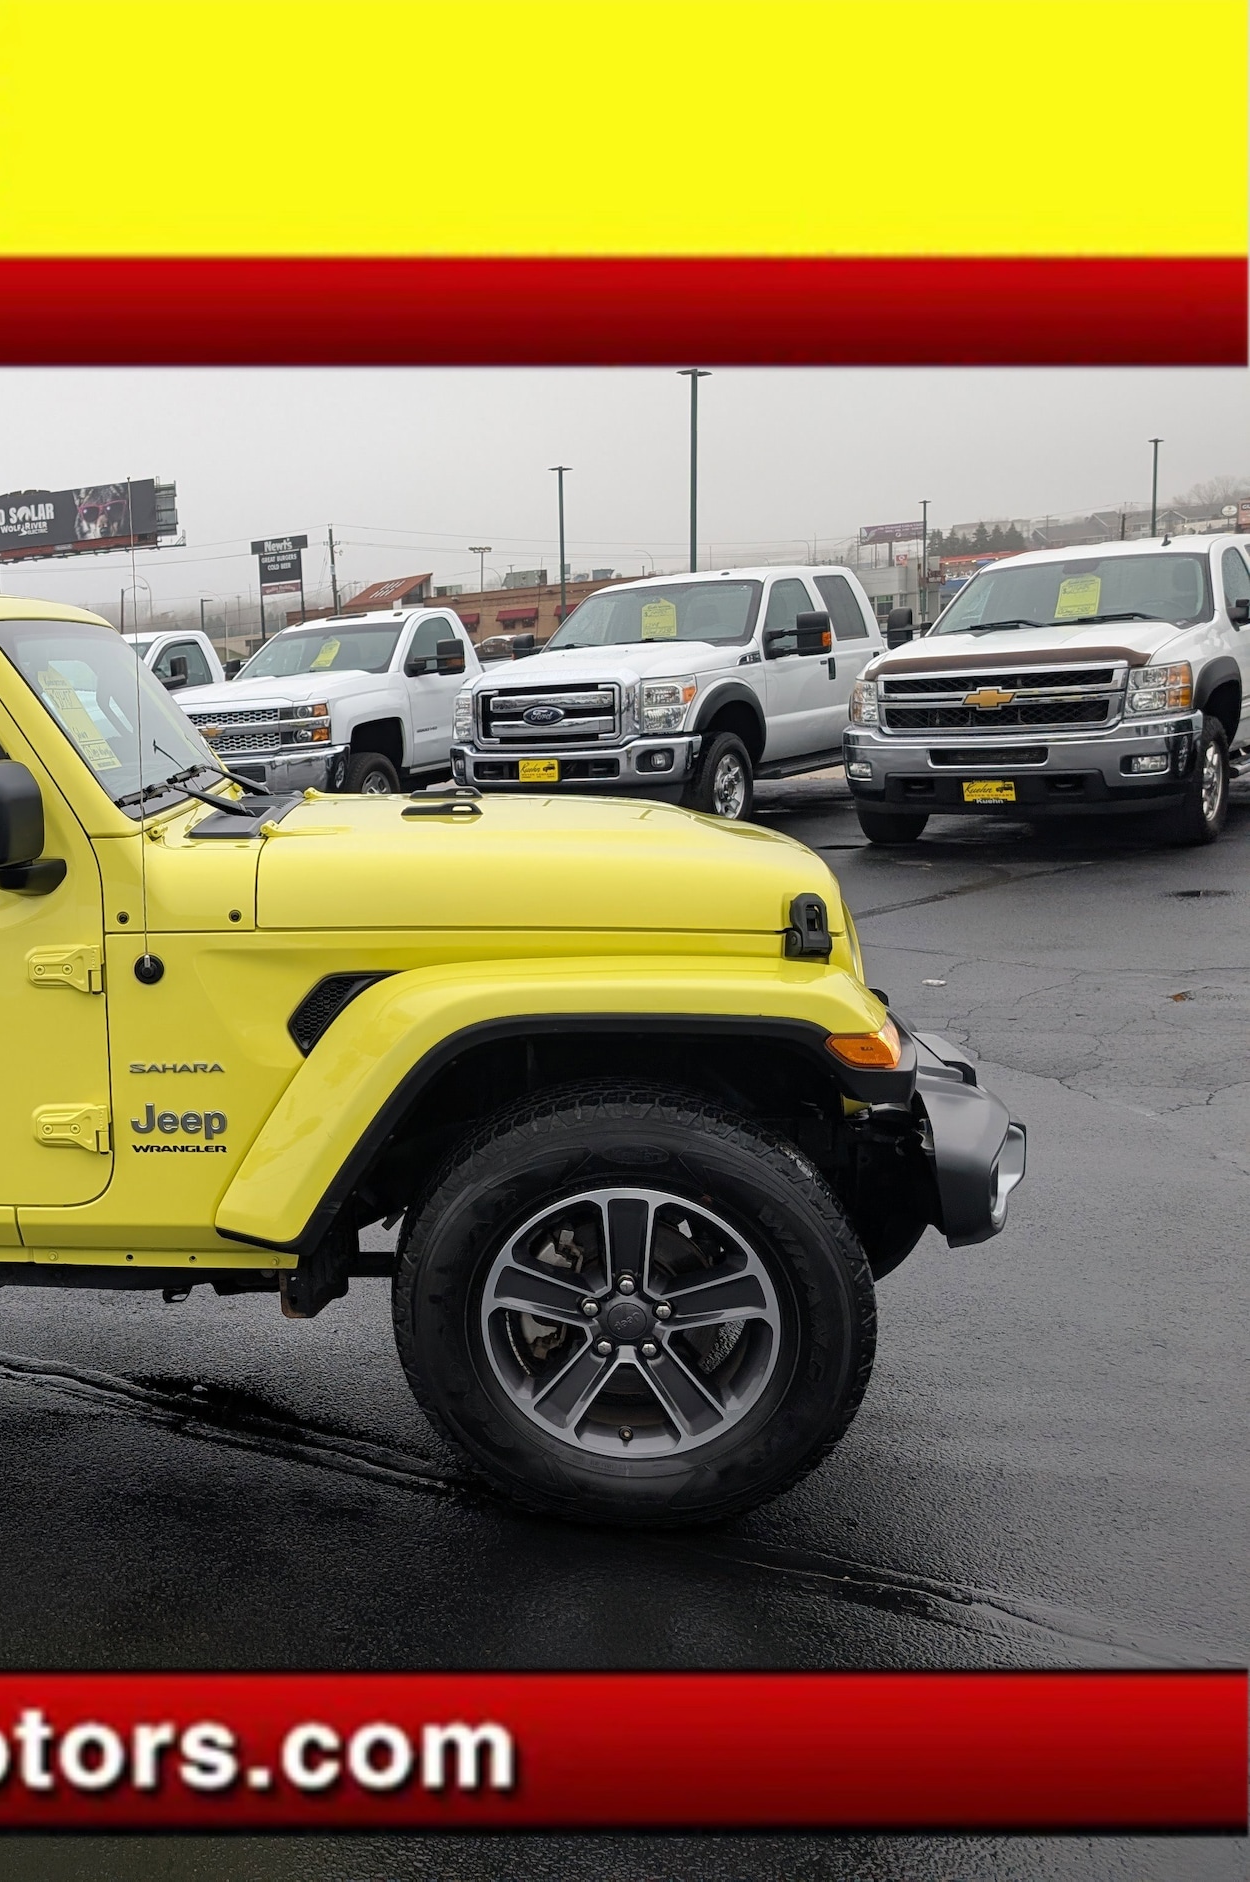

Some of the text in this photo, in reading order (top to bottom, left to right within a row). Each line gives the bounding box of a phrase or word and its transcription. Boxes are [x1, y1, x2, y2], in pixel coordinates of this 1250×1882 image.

[9, 503, 54, 524] SOLAR
[0, 521, 47, 534] WOLF RIVER
[264, 538, 293, 552] Newt's
[268, 563, 280, 571] COLD
[531, 709, 553, 720] Ford
[129, 1063, 225, 1074] SAHARA
[131, 1102, 228, 1140] Jeep
[131, 1144, 228, 1153] WRANGLER
